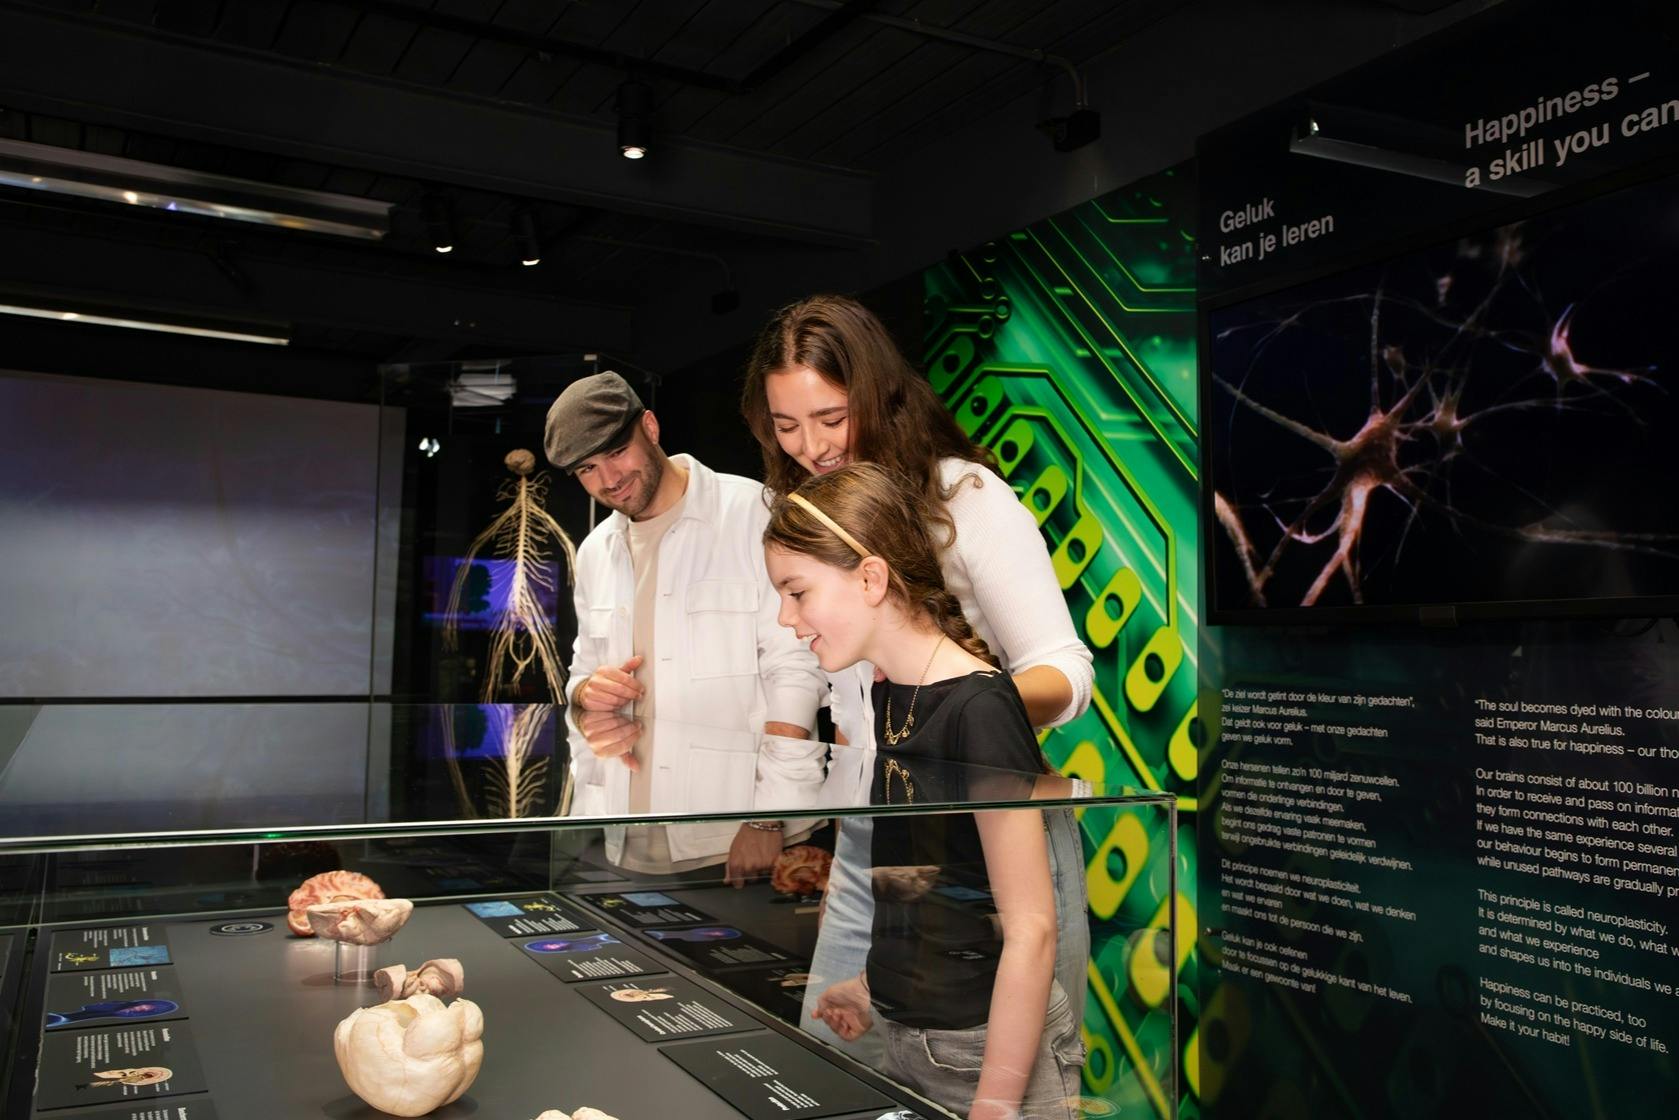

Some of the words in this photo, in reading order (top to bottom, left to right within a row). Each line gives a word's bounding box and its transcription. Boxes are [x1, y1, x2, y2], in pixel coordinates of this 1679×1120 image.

[1466, 78, 1618, 148] Happiness
[1465, 167, 1480, 188] a
[1489, 139, 1543, 180] skill
[1554, 123, 1609, 166] you
[1622, 100, 1679, 136] can
[1220, 198, 1274, 233] Geluk
[1221, 242, 1252, 266] kan
[1259, 233, 1276, 260] je
[1283, 216, 1333, 246] leren
[1247, 691, 1266, 699] wordt
[1288, 692, 1305, 701] door
[1307, 693, 1316, 702] de
[1318, 693, 1336, 702] kleur
[1353, 695, 1366, 706] zijn
[1499, 702, 1518, 711] soul
[1521, 702, 1567, 714] becomes
[1570, 704, 1596, 717] dyed
[1599, 705, 1621, 716] with
[1624, 706, 1642, 718] the
[1221, 717, 1233, 726] Dat
[1252, 720, 1265, 728] ook
[1284, 722, 1302, 732] geluk
[1311, 725, 1325, 733] met
[1327, 726, 1345, 734] onze
[1347, 727, 1388, 737] gedachten
[1475, 717, 1494, 727] said
[1497, 718, 1538, 731] Emperor
[1541, 720, 1577, 733] Marcus
[1580, 723, 1625, 735] Aurelius.
[1475, 734, 1496, 745] That
[1499, 736, 1506, 746] is
[1509, 737, 1529, 747] also
[1531, 739, 1551, 749] true
[1553, 739, 1567, 750] for
[1570, 740, 1624, 754] happiness
[1638, 747, 1657, 756] our
[1221, 773, 1234, 783] Om
[1268, 780, 1275, 788] te
[1327, 786, 1345, 796] door
[1346, 788, 1354, 798] te
[1356, 791, 1381, 801] geven,
[1476, 768, 1493, 779] Our
[1496, 770, 1525, 782] brains
[1527, 775, 1562, 786] consist
[1565, 777, 1576, 787] of
[1578, 778, 1609, 791] about
[1613, 781, 1633, 793] 100
[1637, 783, 1668, 796] billion
[1476, 785, 1484, 795] In
[1487, 788, 1512, 798] order
[1515, 790, 1524, 800] to
[1527, 793, 1562, 804] receive
[1565, 796, 1585, 807] and
[1588, 800, 1614, 810] pass
[1617, 803, 1631, 812] on
[1477, 803, 1496, 816] they
[1498, 805, 1520, 817] form
[1523, 810, 1584, 825] connections
[1587, 817, 1608, 828] with
[1612, 821, 1639, 832] each
[1642, 824, 1673, 836] other.
[1477, 820, 1482, 830] If
[1485, 823, 1499, 832] we
[1501, 823, 1524, 836] have
[1527, 827, 1542, 838] the
[1545, 831, 1573, 842] same
[1576, 835, 1634, 851] experience
[1638, 843, 1677, 856] several
[1477, 839, 1492, 848] our
[1495, 840, 1542, 856] behaviour
[1545, 847, 1579, 862] begins
[1581, 853, 1592, 864] to
[1595, 854, 1619, 867] form
[1477, 856, 1501, 868] while
[1504, 861, 1539, 874] unused
[1542, 867, 1590, 883] pathways
[1593, 875, 1610, 885] are
[1614, 878, 1663, 896] gradually
[1222, 874, 1233, 883] Het
[1235, 878, 1254, 887] wordt
[1284, 886, 1301, 897] door
[1303, 892, 1316, 900] wat
[1318, 894, 1329, 903] we
[1331, 896, 1353, 908] doen,
[1355, 902, 1369, 911] wat
[1371, 905, 1383, 914] we
[1386, 907, 1416, 920] denken
[1478, 889, 1497, 902] This
[1500, 895, 1540, 910] principle
[1543, 901, 1551, 912] is
[1554, 905, 1584, 918] called
[1588, 912, 1668, 936] neuroplasticity.
[1254, 911, 1267, 920] ons
[1268, 913, 1278, 923] tot
[1279, 915, 1289, 925] de
[1322, 925, 1334, 935] die
[1335, 929, 1347, 938] we
[1349, 931, 1363, 943] zijn.
[1479, 907, 1484, 917] It
[1487, 908, 1495, 919] is
[1497, 911, 1551, 930] determined
[1555, 922, 1567, 935] by
[1570, 926, 1595, 939] what
[1599, 932, 1615, 943] we
[1618, 935, 1635, 948] do,
[1640, 940, 1667, 954] what
[1479, 927, 1496, 937] and
[1499, 930, 1522, 943] what
[1525, 936, 1540, 946] we
[1543, 940, 1599, 959] experience
[1479, 944, 1497, 955] and
[1500, 947, 1535, 963] shapes
[1538, 957, 1550, 967] us
[1553, 958, 1571, 972] into
[1575, 963, 1591, 976] the
[1594, 967, 1651, 990] individuals
[1654, 983, 1671, 994] we
[1480, 977, 1530, 999] Happiness
[1533, 993, 1552, 1004] can
[1555, 995, 1568, 1008] be
[1572, 1002, 1624, 1023] practiced,
[1628, 1014, 1646, 1027] too
[1481, 995, 1492, 1008] by
[1495, 998, 1535, 1020] focusing
[1538, 1012, 1551, 1022] on
[1554, 1014, 1570, 1027] the
[1573, 1018, 1606, 1039] happy
[1610, 1029, 1632, 1043] side
[1636, 1037, 1647, 1047] of
[1650, 1038, 1668, 1053] life.
[1481, 1012, 1506, 1028] Make
[1510, 1020, 1515, 1031] it
[1518, 1025, 1540, 1037] your
[1543, 1029, 1570, 1046] habit!
